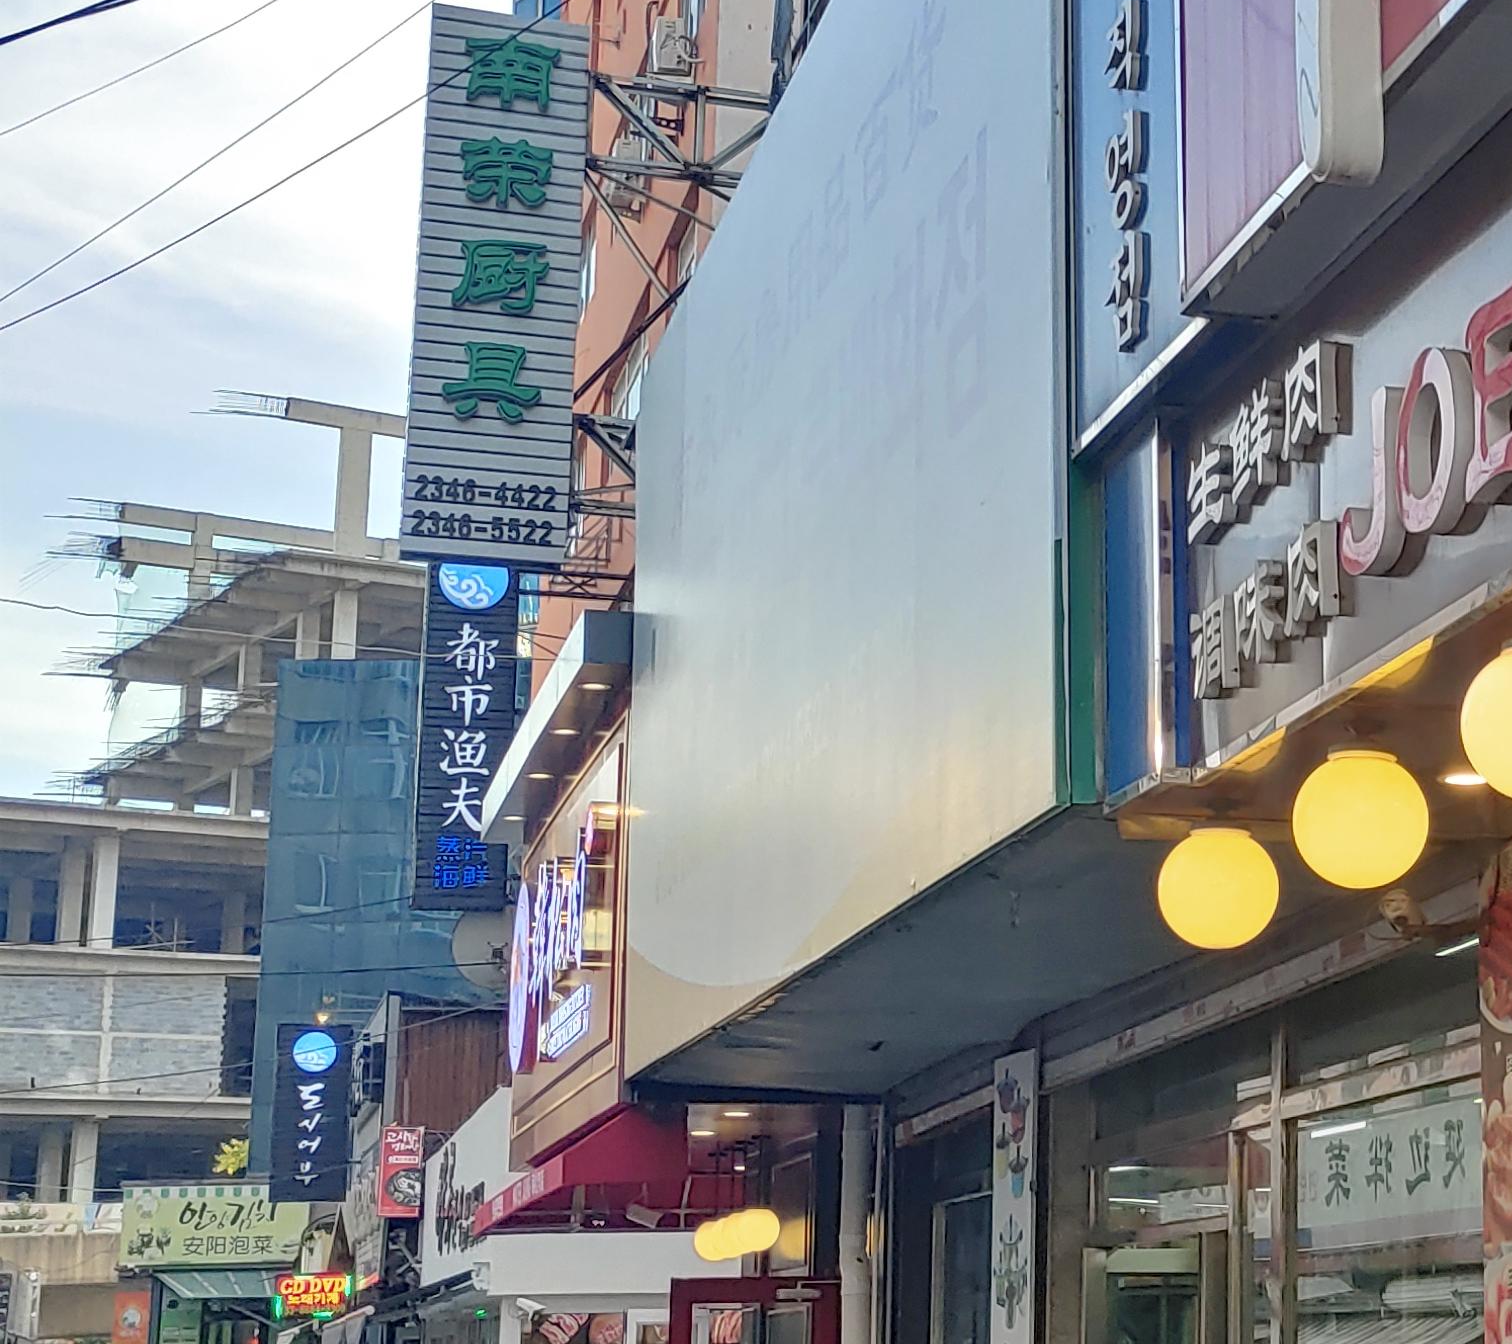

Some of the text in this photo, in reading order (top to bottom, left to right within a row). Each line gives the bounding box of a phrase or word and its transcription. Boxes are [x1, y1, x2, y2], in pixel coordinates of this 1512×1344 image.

[1188, 339, 1350, 545] 生鲜肉
[414, 474, 558, 513] 2346-4422
[410, 509, 554, 546] 2346-5522
[1190, 520, 1342, 700] 调味肉
[438, 623, 497, 833] 都市渔夫
[182, 1236, 274, 1256] 安阳泡菜
[280, 1277, 346, 1295] CD DVD
